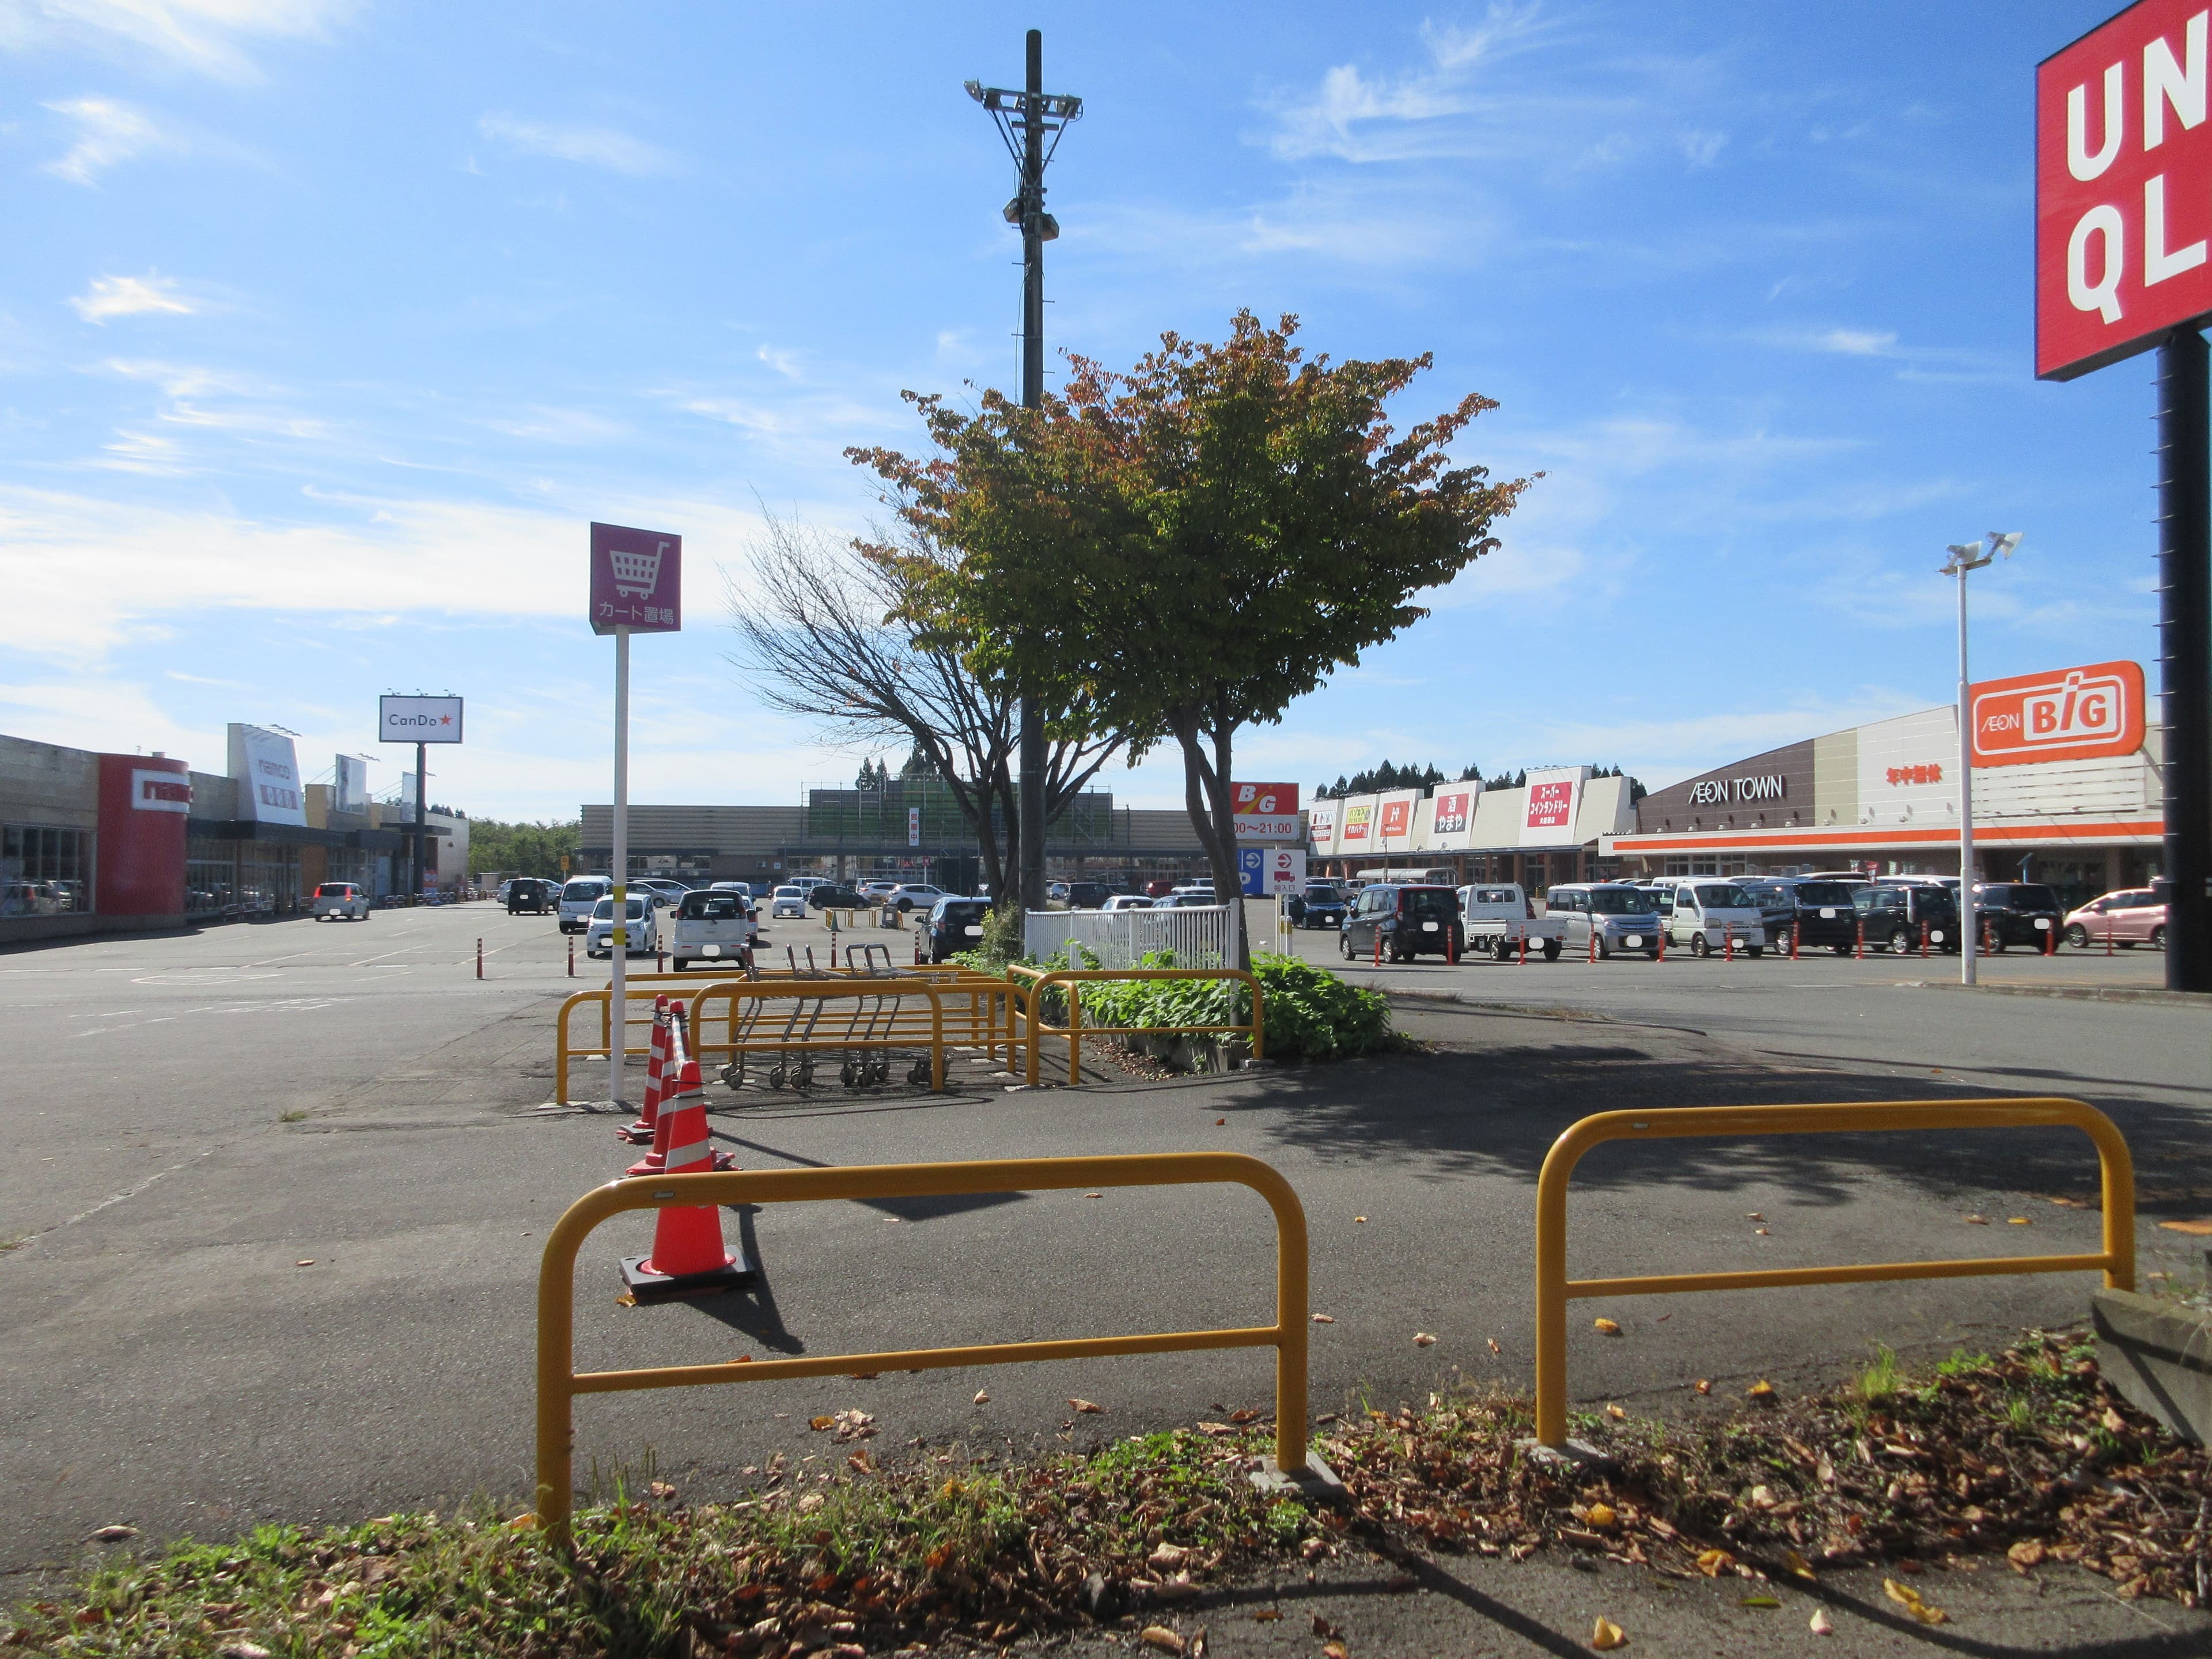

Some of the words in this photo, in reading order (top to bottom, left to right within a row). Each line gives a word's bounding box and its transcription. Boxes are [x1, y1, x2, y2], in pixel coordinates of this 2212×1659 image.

[599, 602, 674, 625] カート置場
[389, 714, 437, 726] CanDo
[1540, 784, 1560, 800] スーパー
[1734, 775, 1782, 800] TOWN
[1447, 796, 1457, 813] 酒
[1530, 800, 1567, 815] コインランドリー
[1438, 813, 1463, 832] やまや
